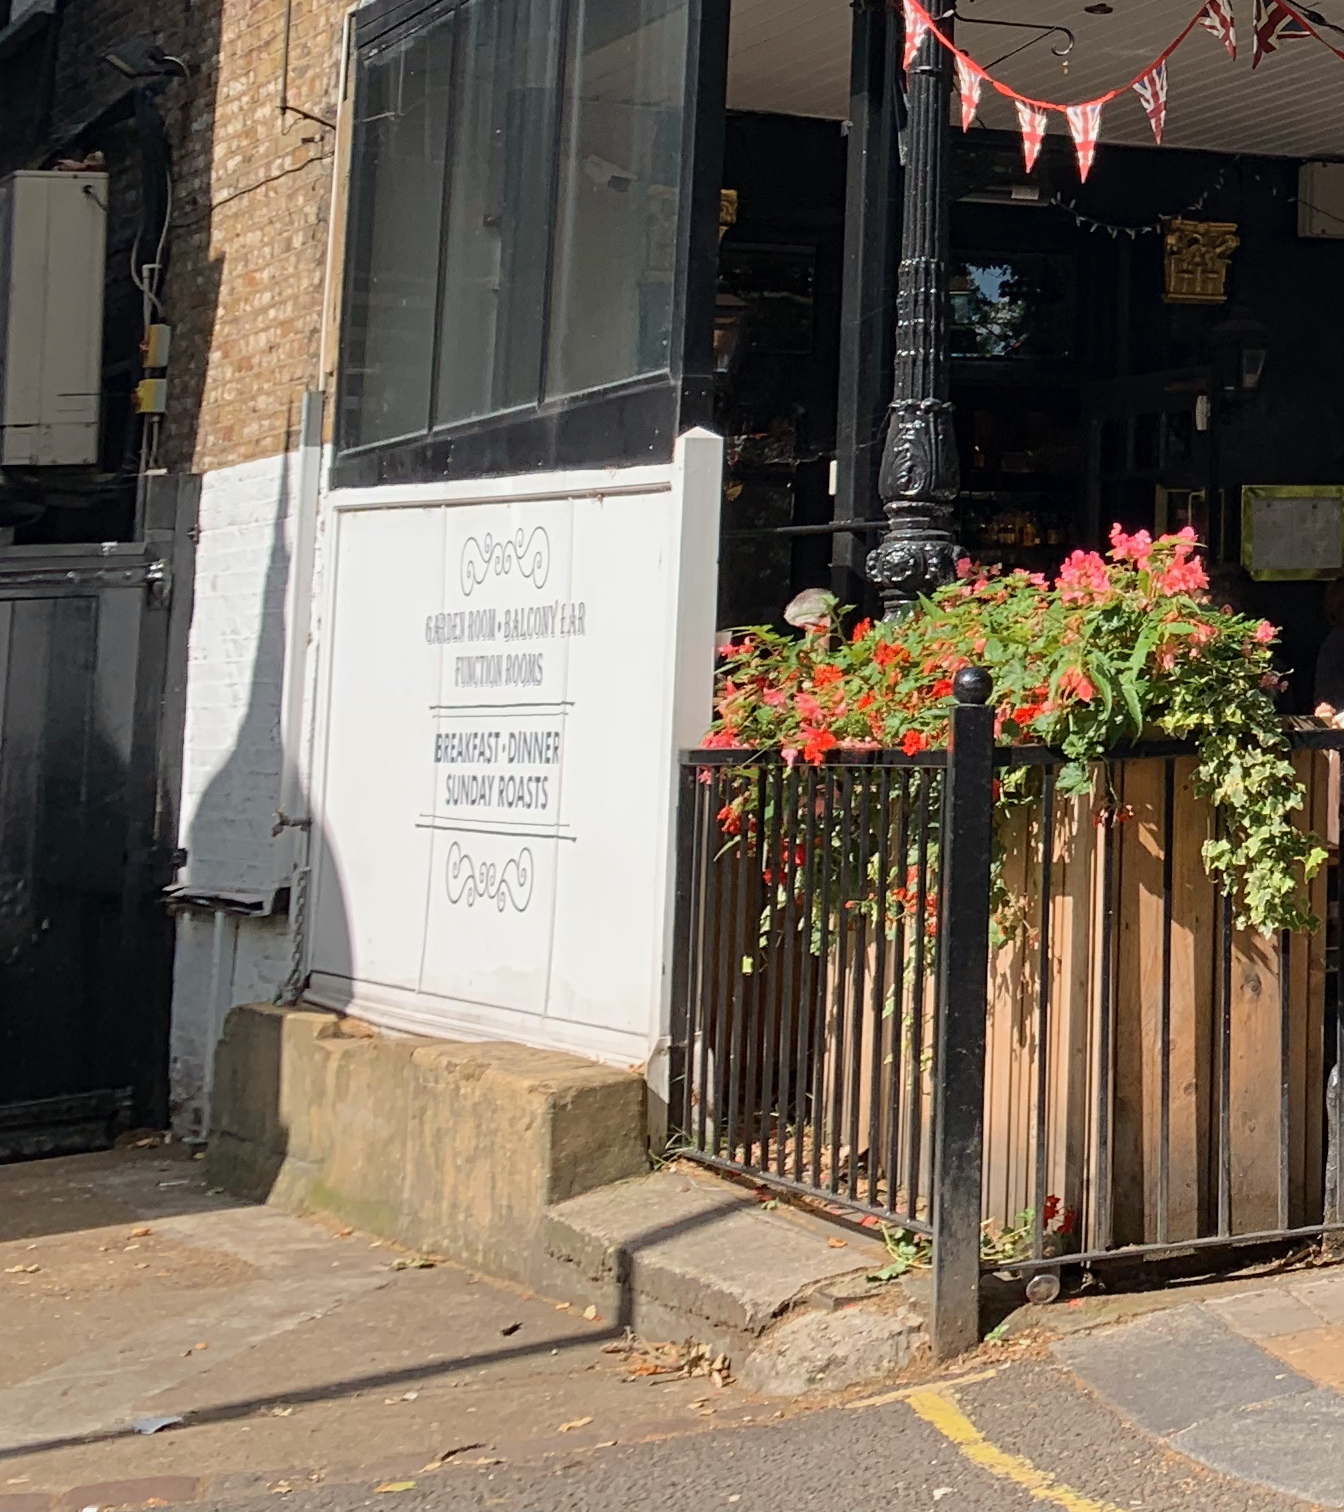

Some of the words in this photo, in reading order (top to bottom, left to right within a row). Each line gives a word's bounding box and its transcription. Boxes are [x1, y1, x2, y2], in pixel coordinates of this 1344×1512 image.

[425, 612, 466, 645] GARDEN
[467, 608, 497, 641] ROOM
[504, 599, 559, 641] BALCONY
[455, 654, 503, 688] FUNCTION
[505, 653, 544, 687] ROOMS
[434, 732, 501, 764] BREAKFAST
[507, 731, 560, 764] DINNER
[445, 773, 495, 807] SUNDAY
[497, 774, 549, 810] ROASTS
